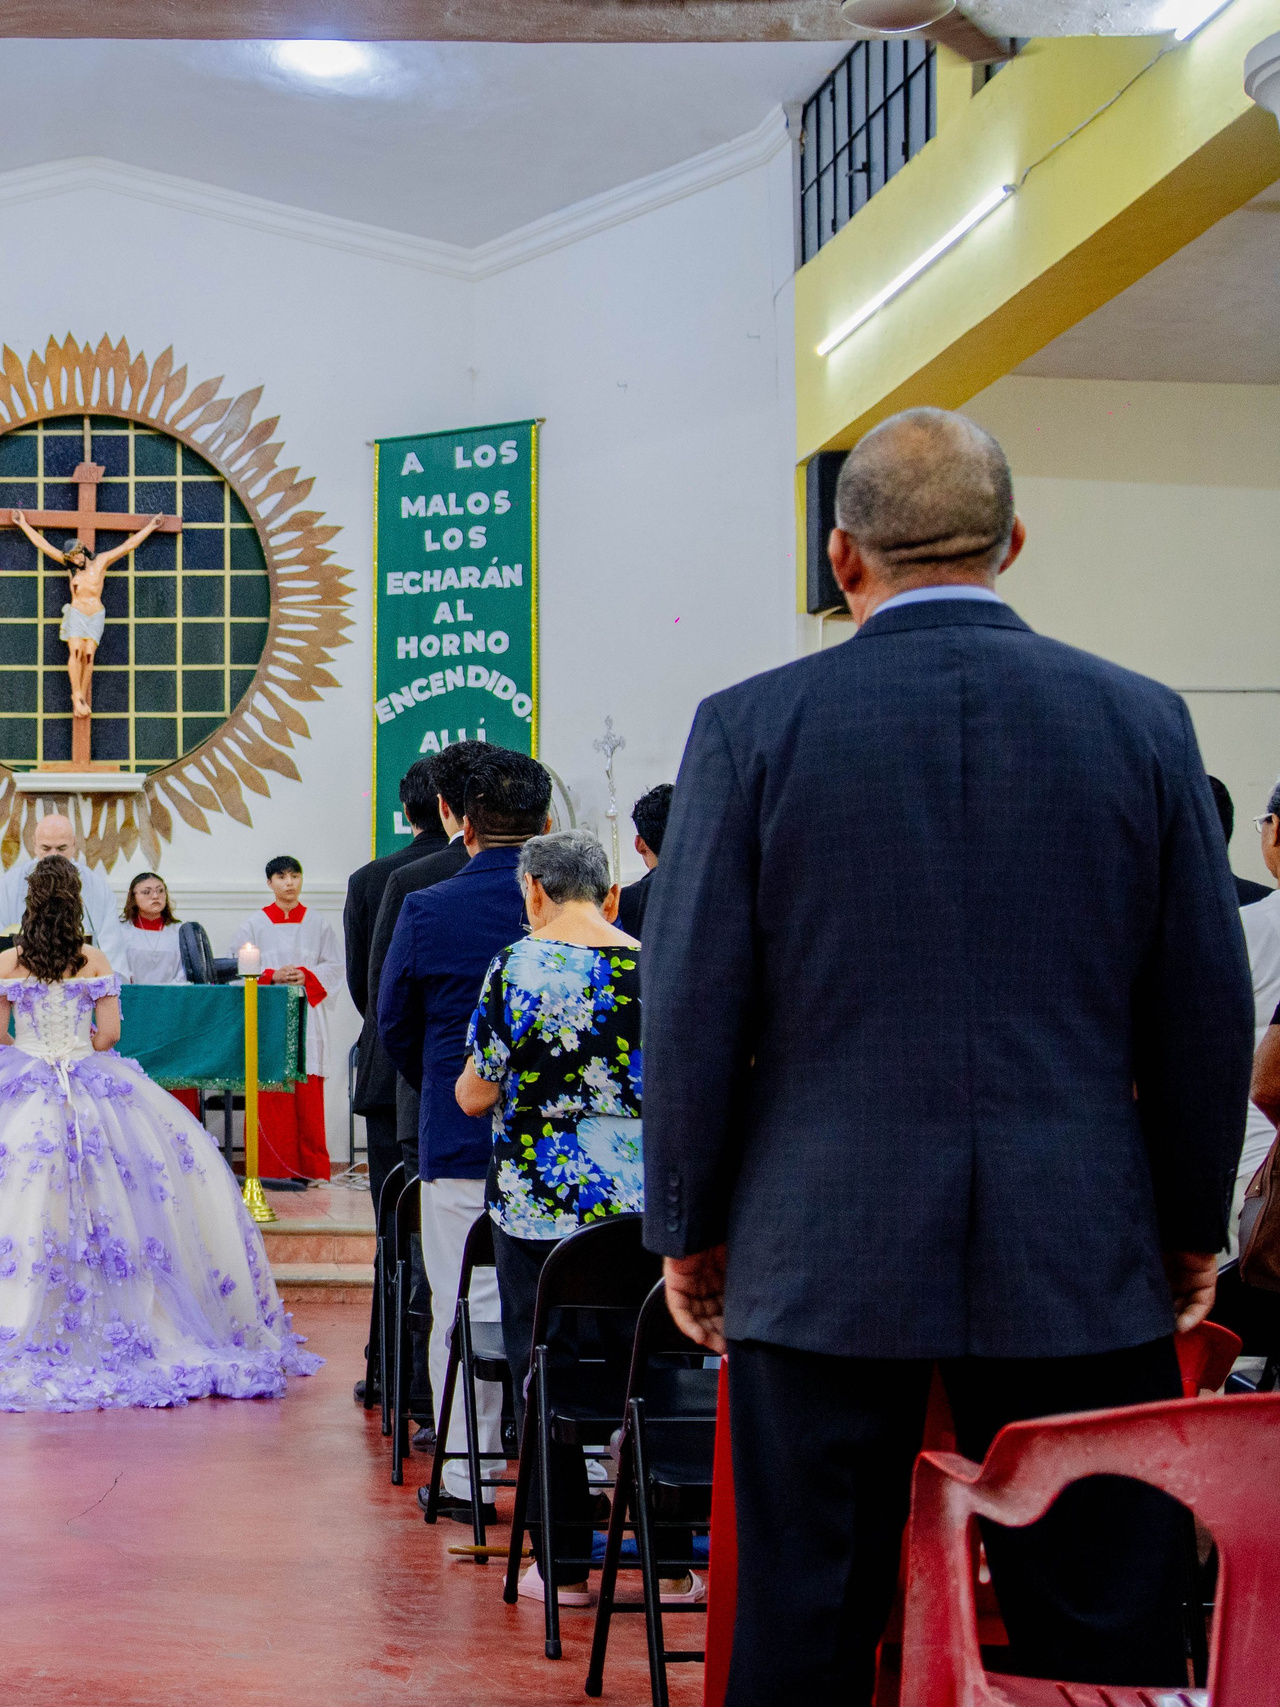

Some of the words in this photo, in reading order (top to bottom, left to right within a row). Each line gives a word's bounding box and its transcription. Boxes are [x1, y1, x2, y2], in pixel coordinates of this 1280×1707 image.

[401, 452, 424, 476] A
[455, 440, 518, 469] LOS
[401, 490, 511, 518] MALOS
[424, 525, 487, 552] LOS
[387, 557, 523, 595] ECHARÁN
[433, 599, 473, 624] AL
[397, 630, 510, 659] HORNO
[375, 665, 533, 724] ENCENDIDO.
